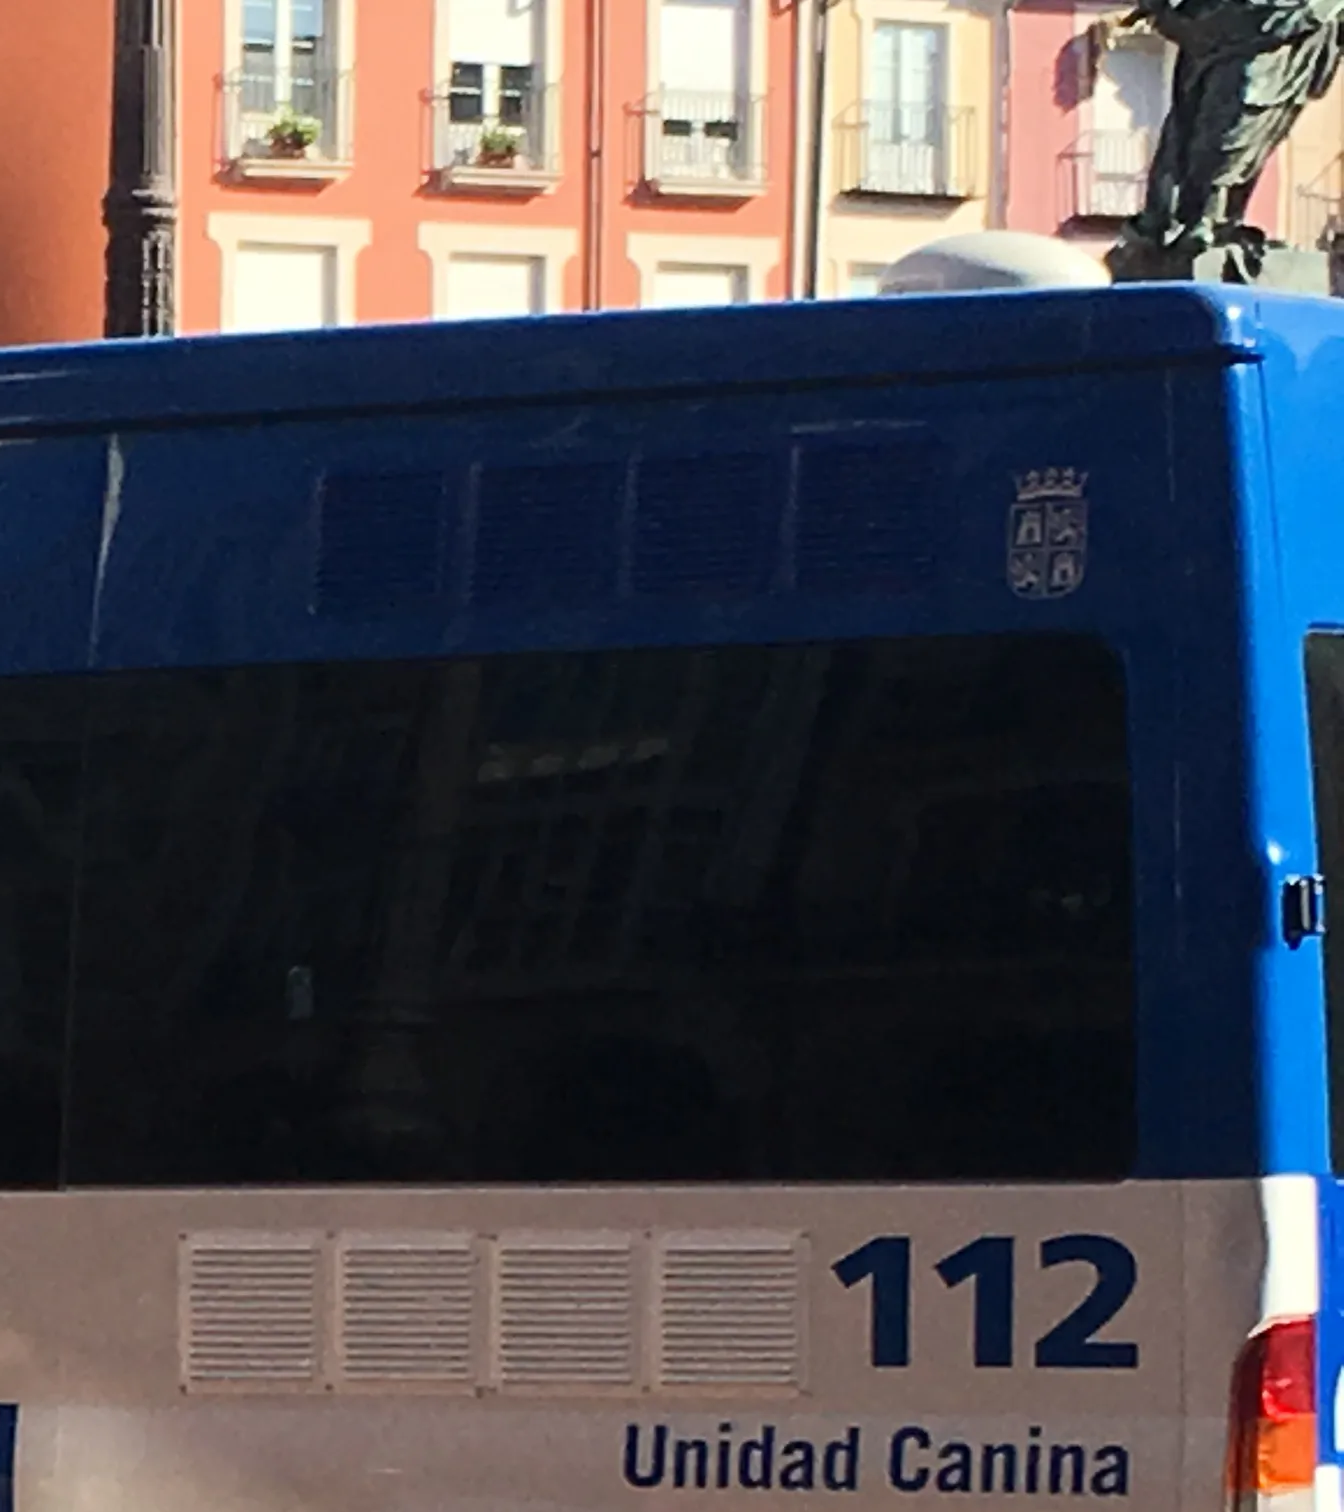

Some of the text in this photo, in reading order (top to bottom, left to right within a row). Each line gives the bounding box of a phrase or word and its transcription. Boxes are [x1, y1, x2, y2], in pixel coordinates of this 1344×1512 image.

[831, 1233, 1139, 1369] 112
[624, 1422, 1129, 1497] Unidad Canina
